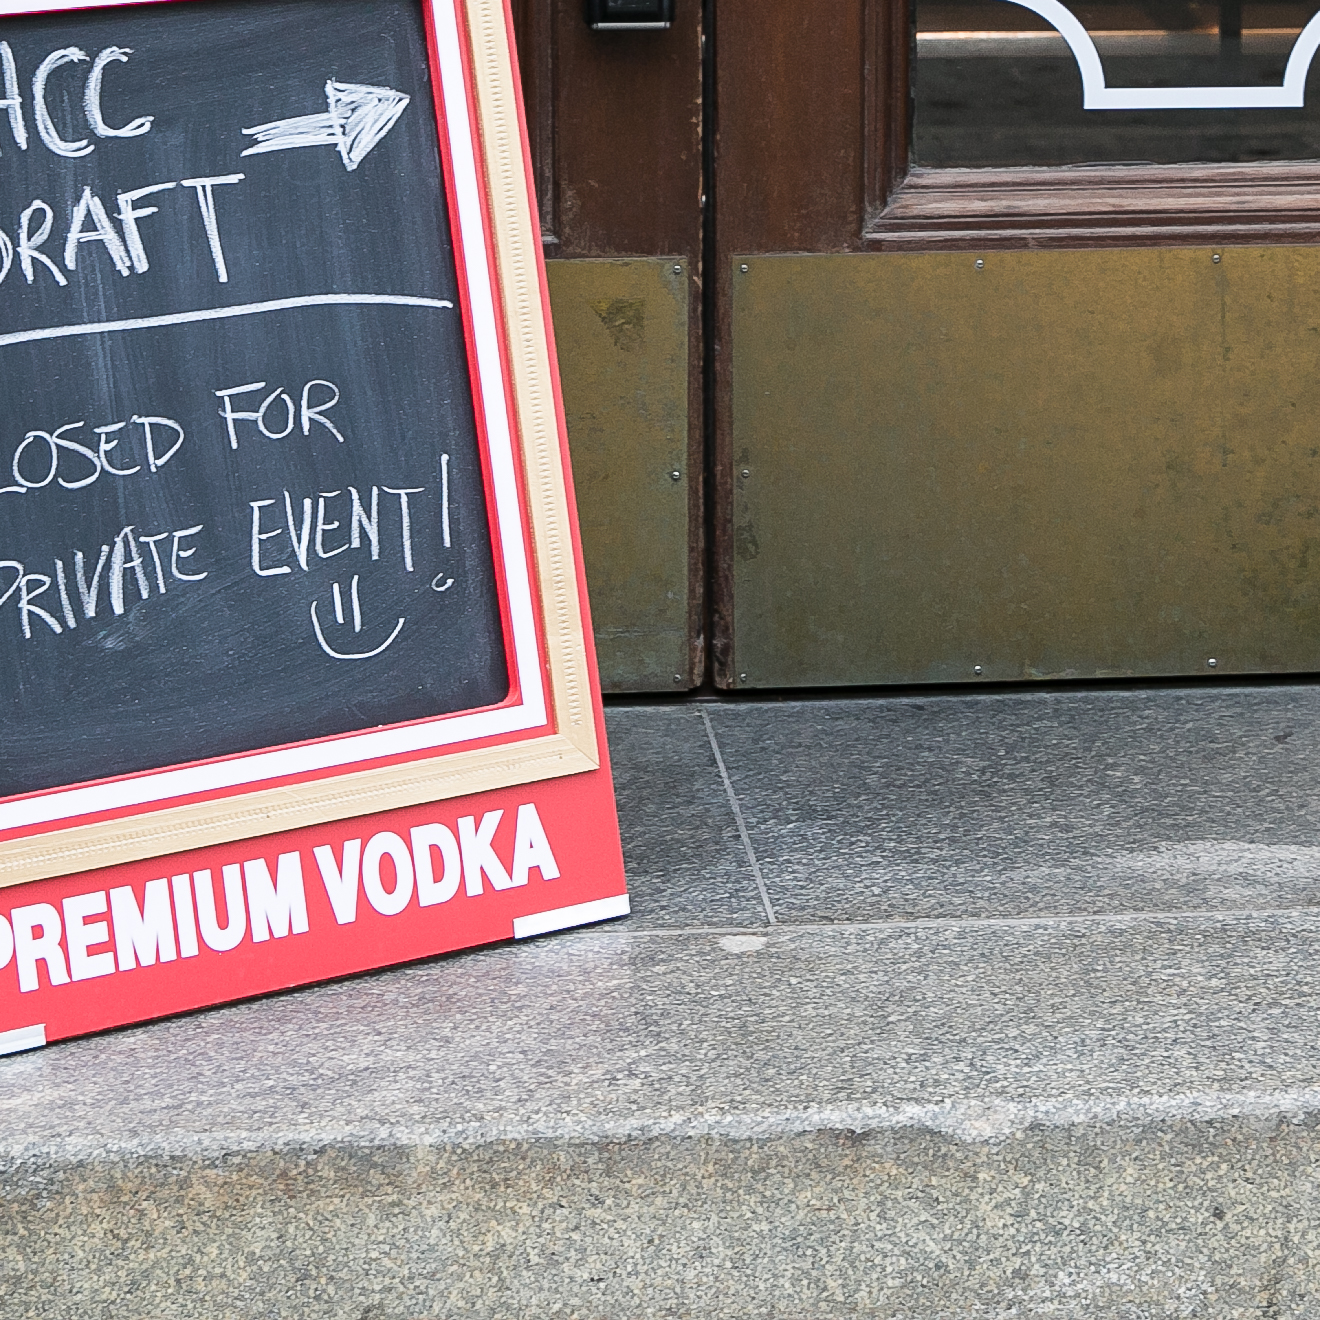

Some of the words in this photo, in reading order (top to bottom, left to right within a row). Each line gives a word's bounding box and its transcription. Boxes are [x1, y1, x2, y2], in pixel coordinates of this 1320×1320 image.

[214, 379, 345, 451] FOR
[250, 453, 455, 592] EVENT!
[313, 801, 561, 926] VODKA
